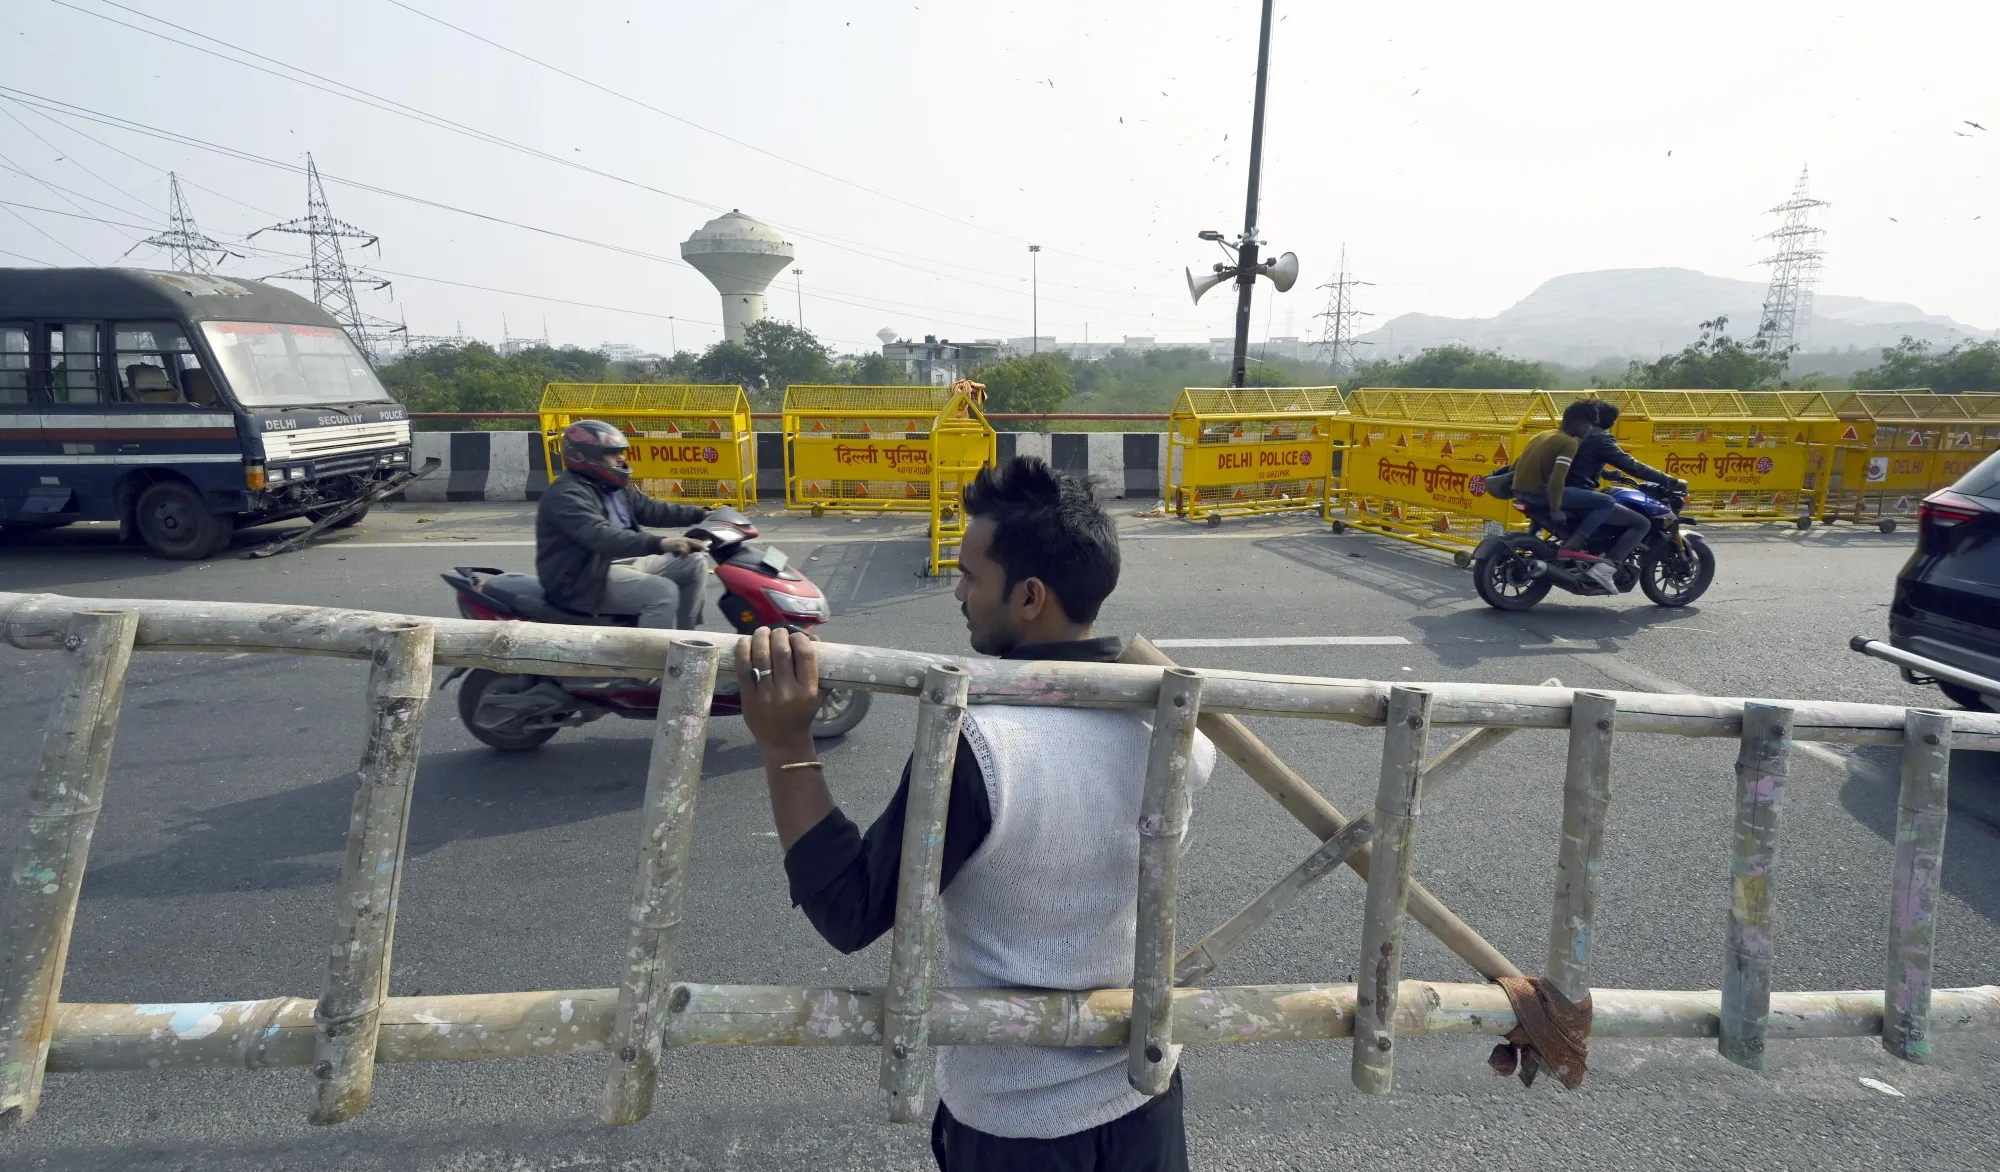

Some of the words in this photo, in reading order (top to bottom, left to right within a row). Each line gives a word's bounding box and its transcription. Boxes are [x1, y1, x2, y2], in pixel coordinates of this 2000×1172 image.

[265, 419, 297, 430] DELHI
[380, 410, 404, 421] POLICE
[650, 445, 702, 462] POLICE
[833, 444, 879, 466] दिल्ली
[882, 444, 928, 469] पुलिस
[1218, 451, 1253, 470] DELHI
[1259, 450, 1299, 467] POLICE
[1665, 452, 1709, 476] दिल्ली
[1713, 452, 1757, 479] पुलिस
[1893, 459, 1924, 475] DELHI
[1942, 459, 1979, 475] POLIC
[1378, 457, 1419, 486] दिल्ली
[1422, 464, 1469, 495] पुलिस
